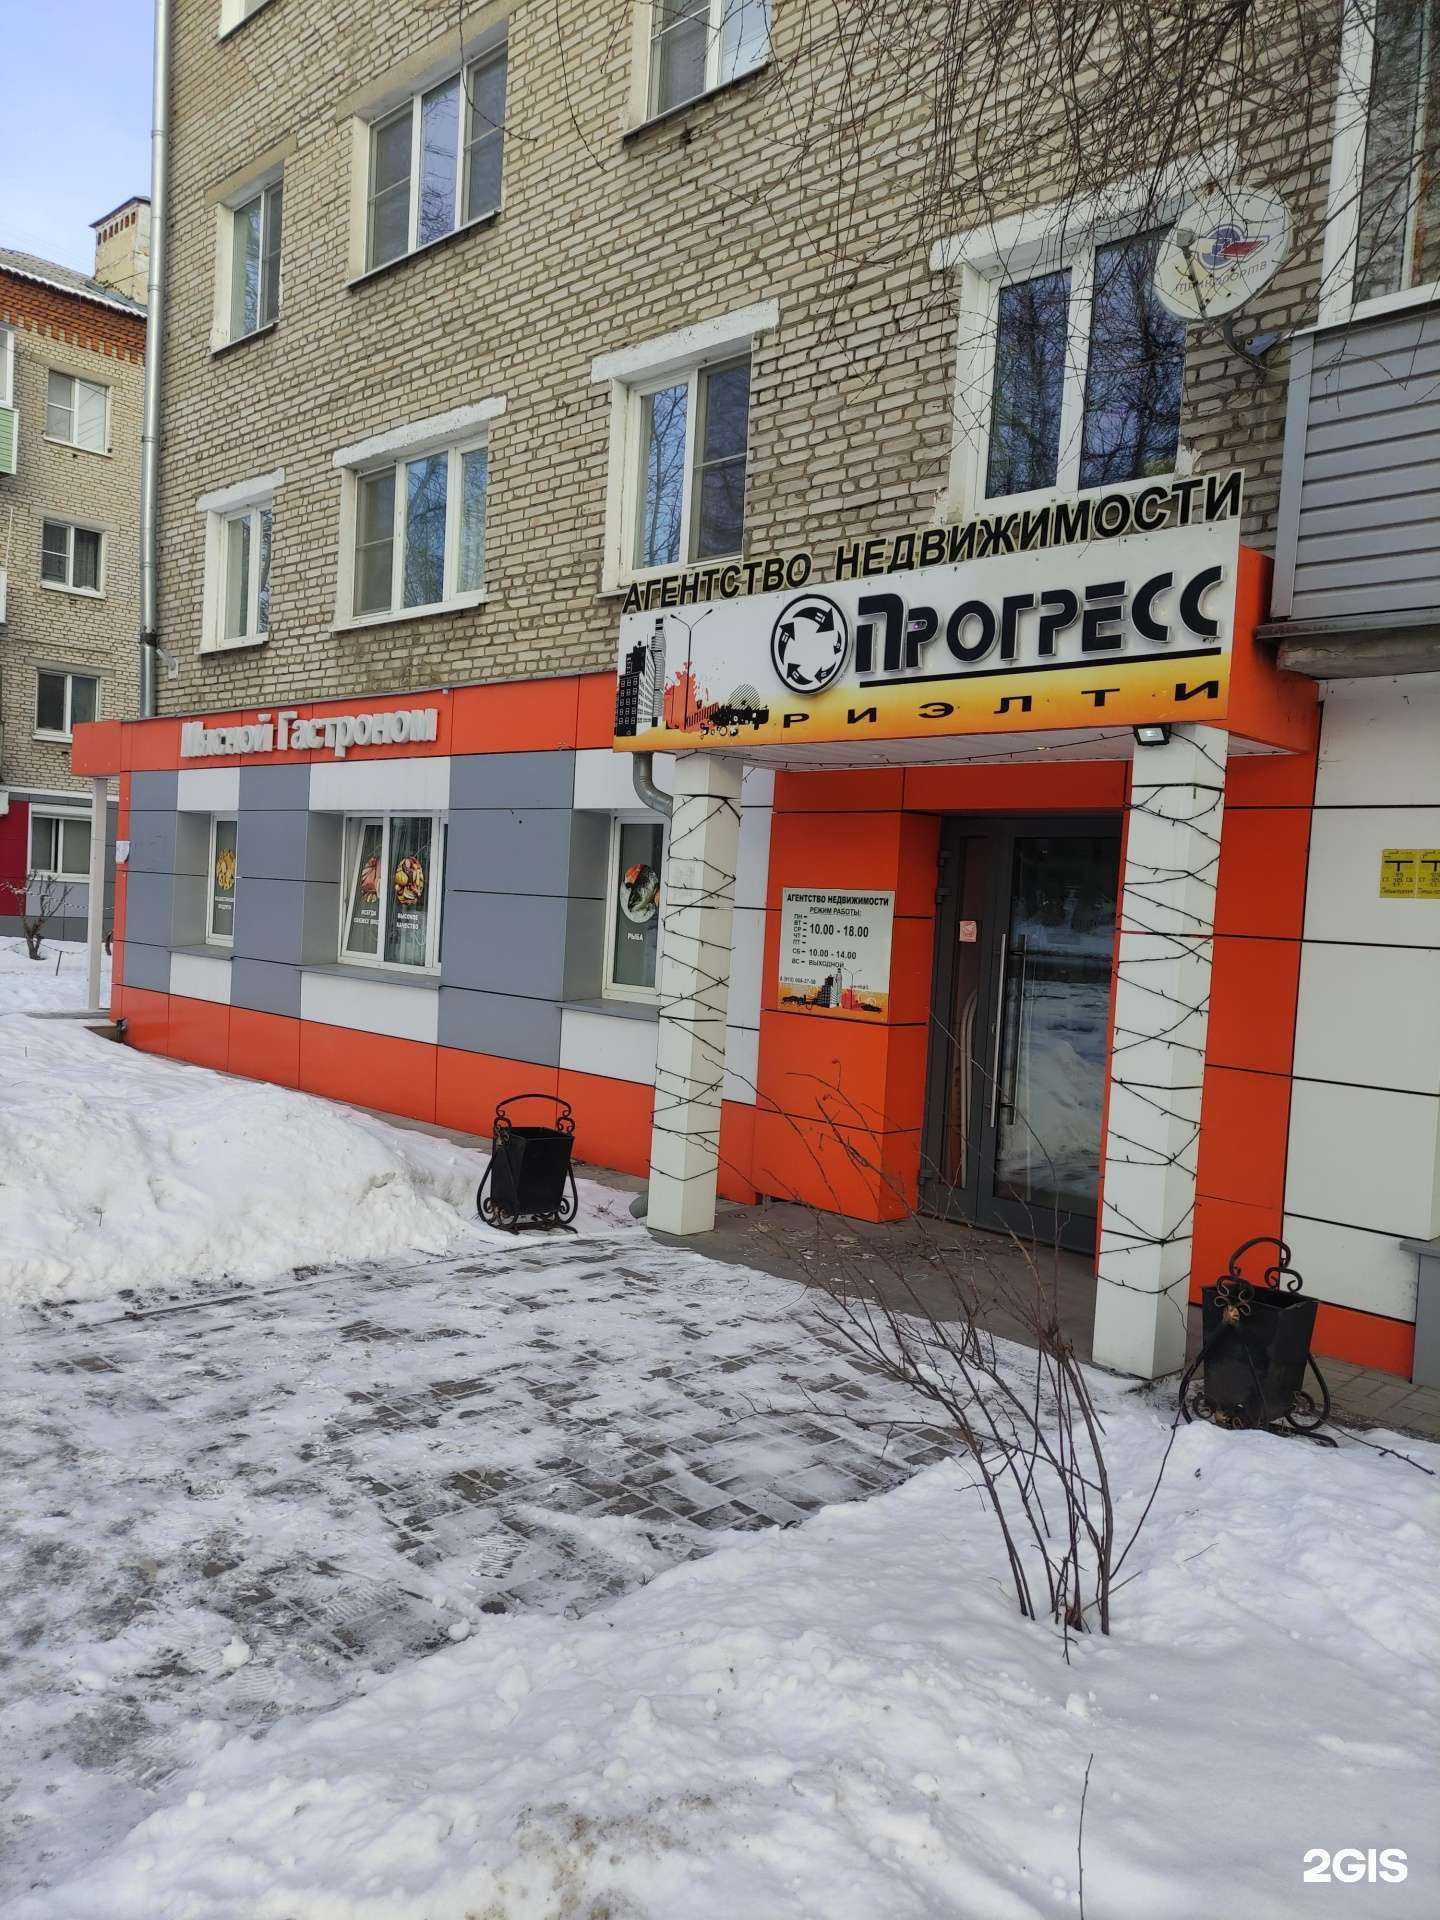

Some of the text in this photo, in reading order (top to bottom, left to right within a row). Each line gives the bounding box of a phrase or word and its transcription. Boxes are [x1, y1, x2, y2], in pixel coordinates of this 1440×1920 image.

[622, 468, 1246, 614] АГЕНТСТВО НЕДВИЖИМОСТИ
[854, 563, 1224, 675] ПРОГРЕСС
[782, 679, 1222, 730] РИЭЛТИ
[277, 708, 438, 758] Гастроном
[787, 893, 889, 906] АГЕНТСТВО НЕДВИЖИМОСТИ
[810, 906, 832, 914] РЕЖИМ
[809, 923, 834, 935] 10.00
[843, 926, 869, 938] 18.00
[809, 949, 829, 957] 10.00
[836, 951, 857, 959] 14.00
